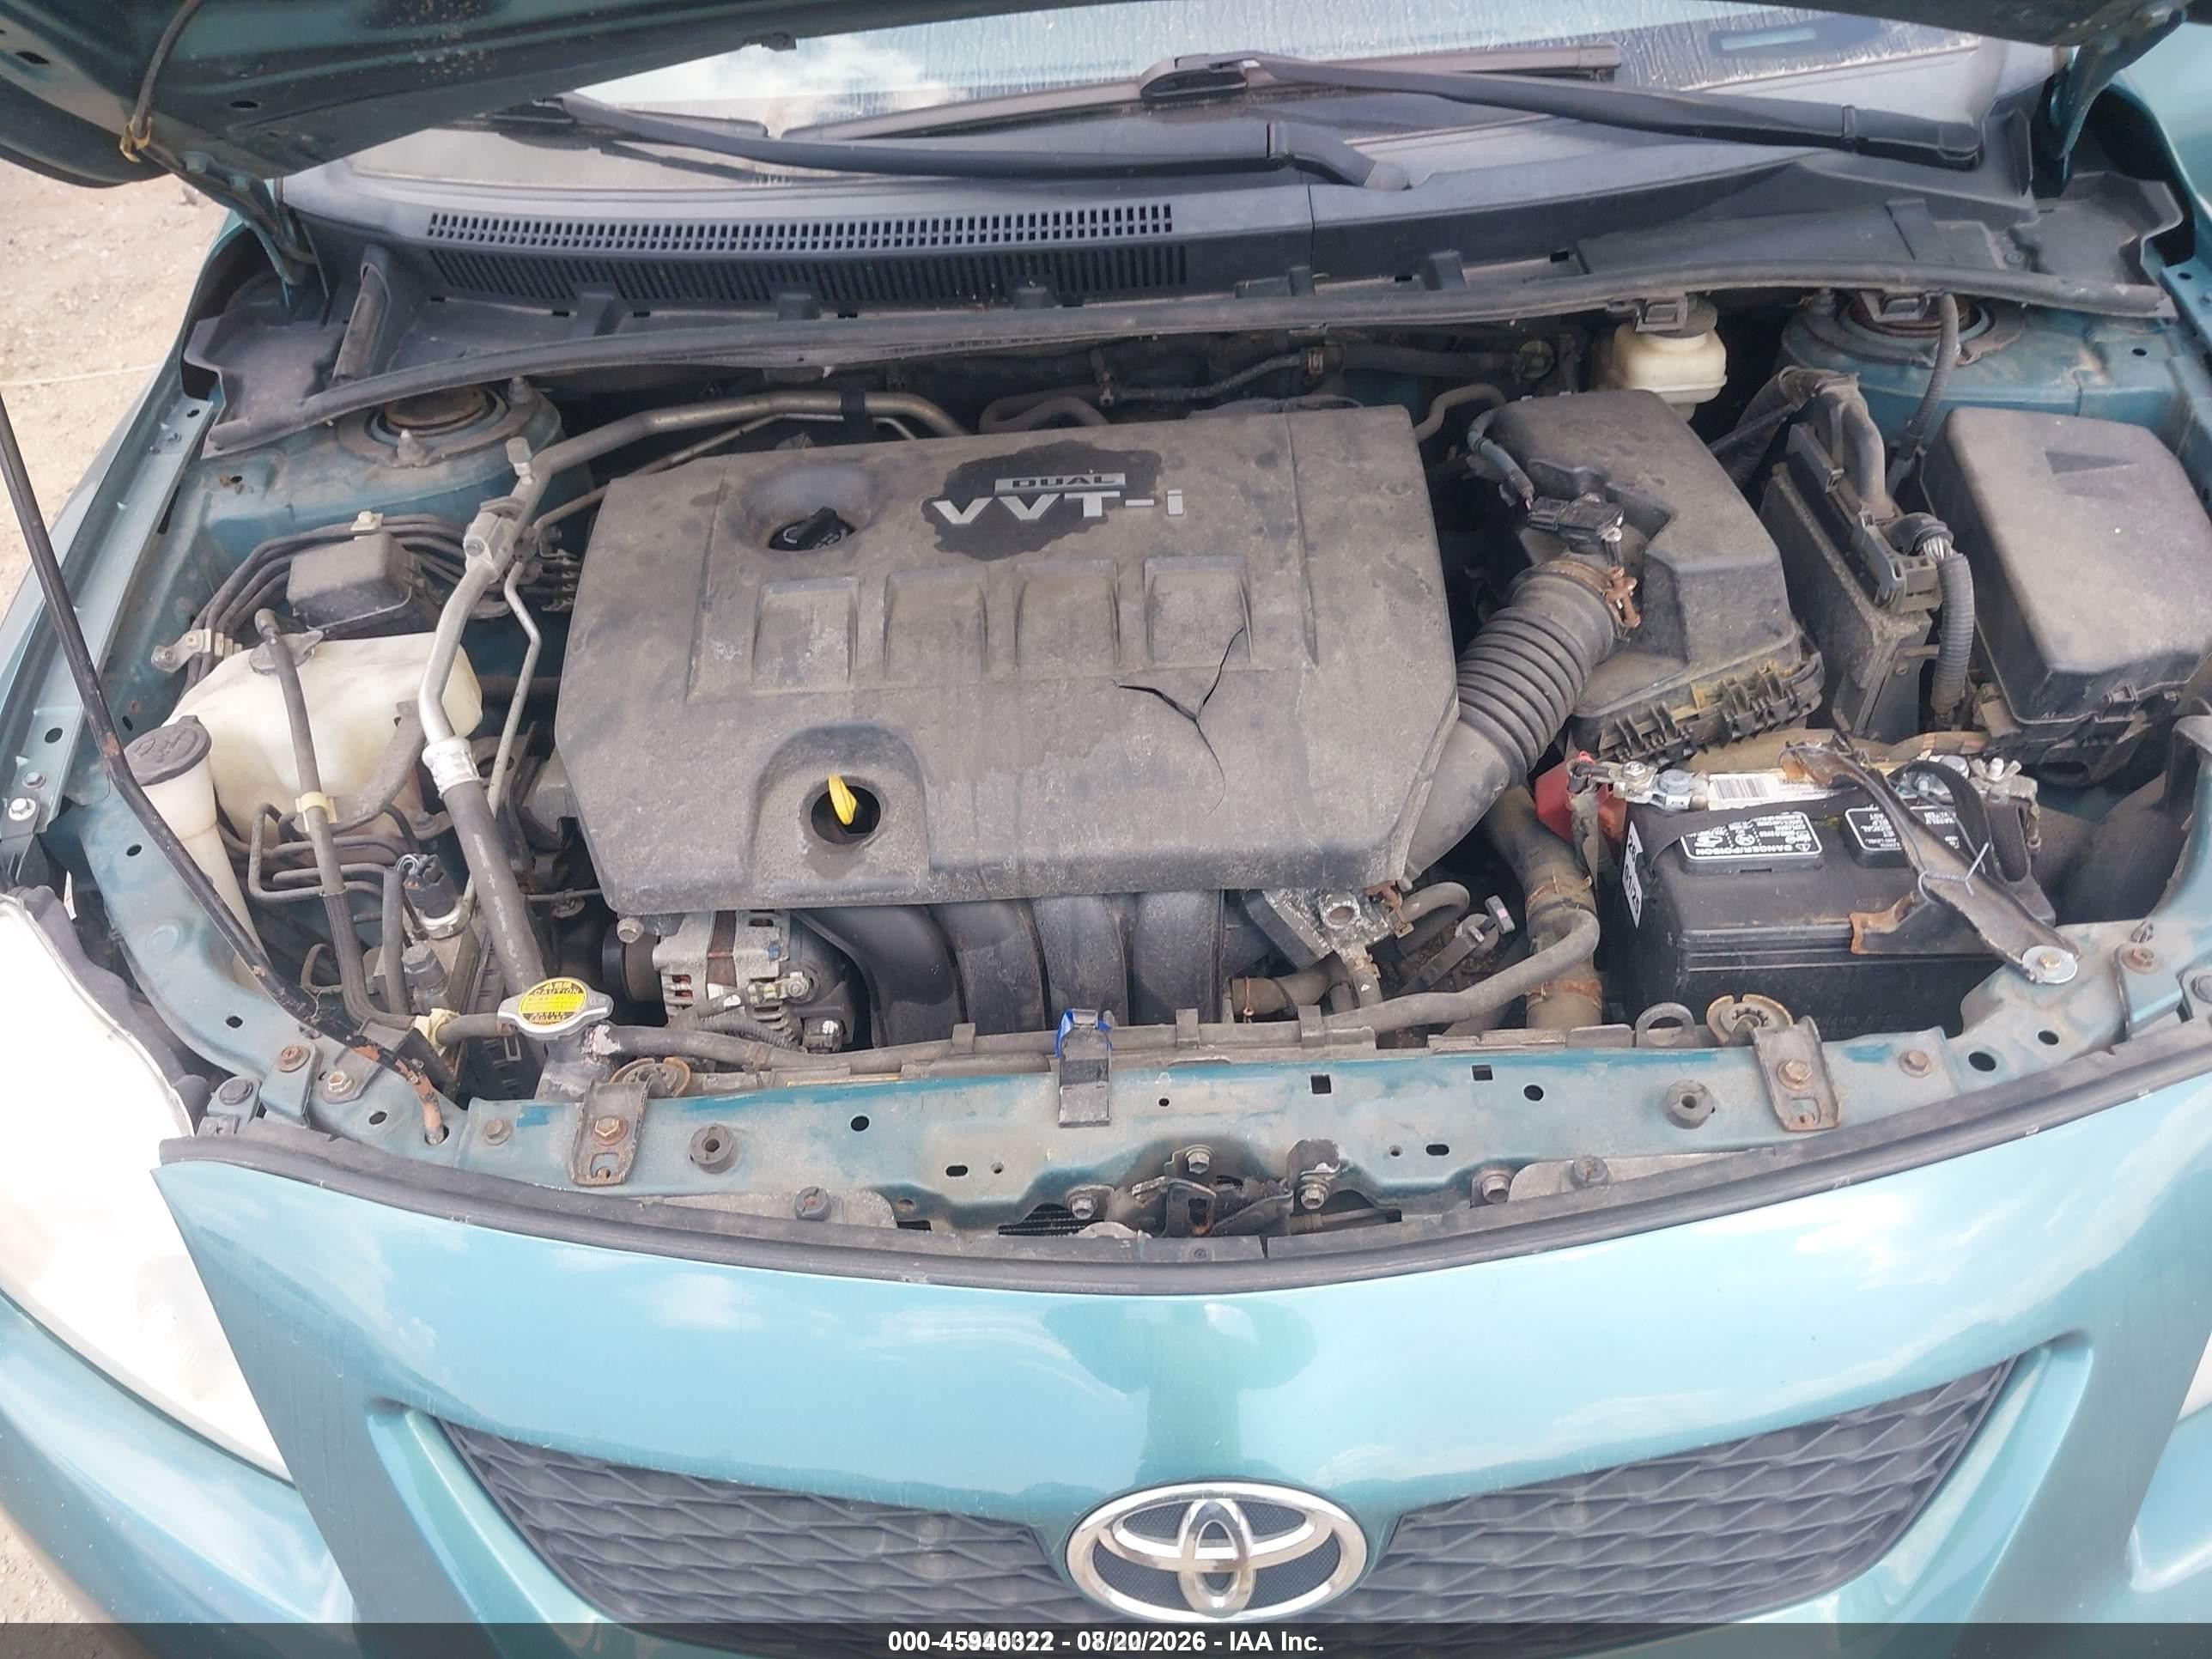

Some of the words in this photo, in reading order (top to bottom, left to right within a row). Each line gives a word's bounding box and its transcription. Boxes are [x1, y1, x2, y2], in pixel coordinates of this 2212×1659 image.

[1012, 476, 1115, 489] DUAL
[932, 489, 1183, 525] VVT-i
[1695, 844, 1793, 855] DANGER/POISON
